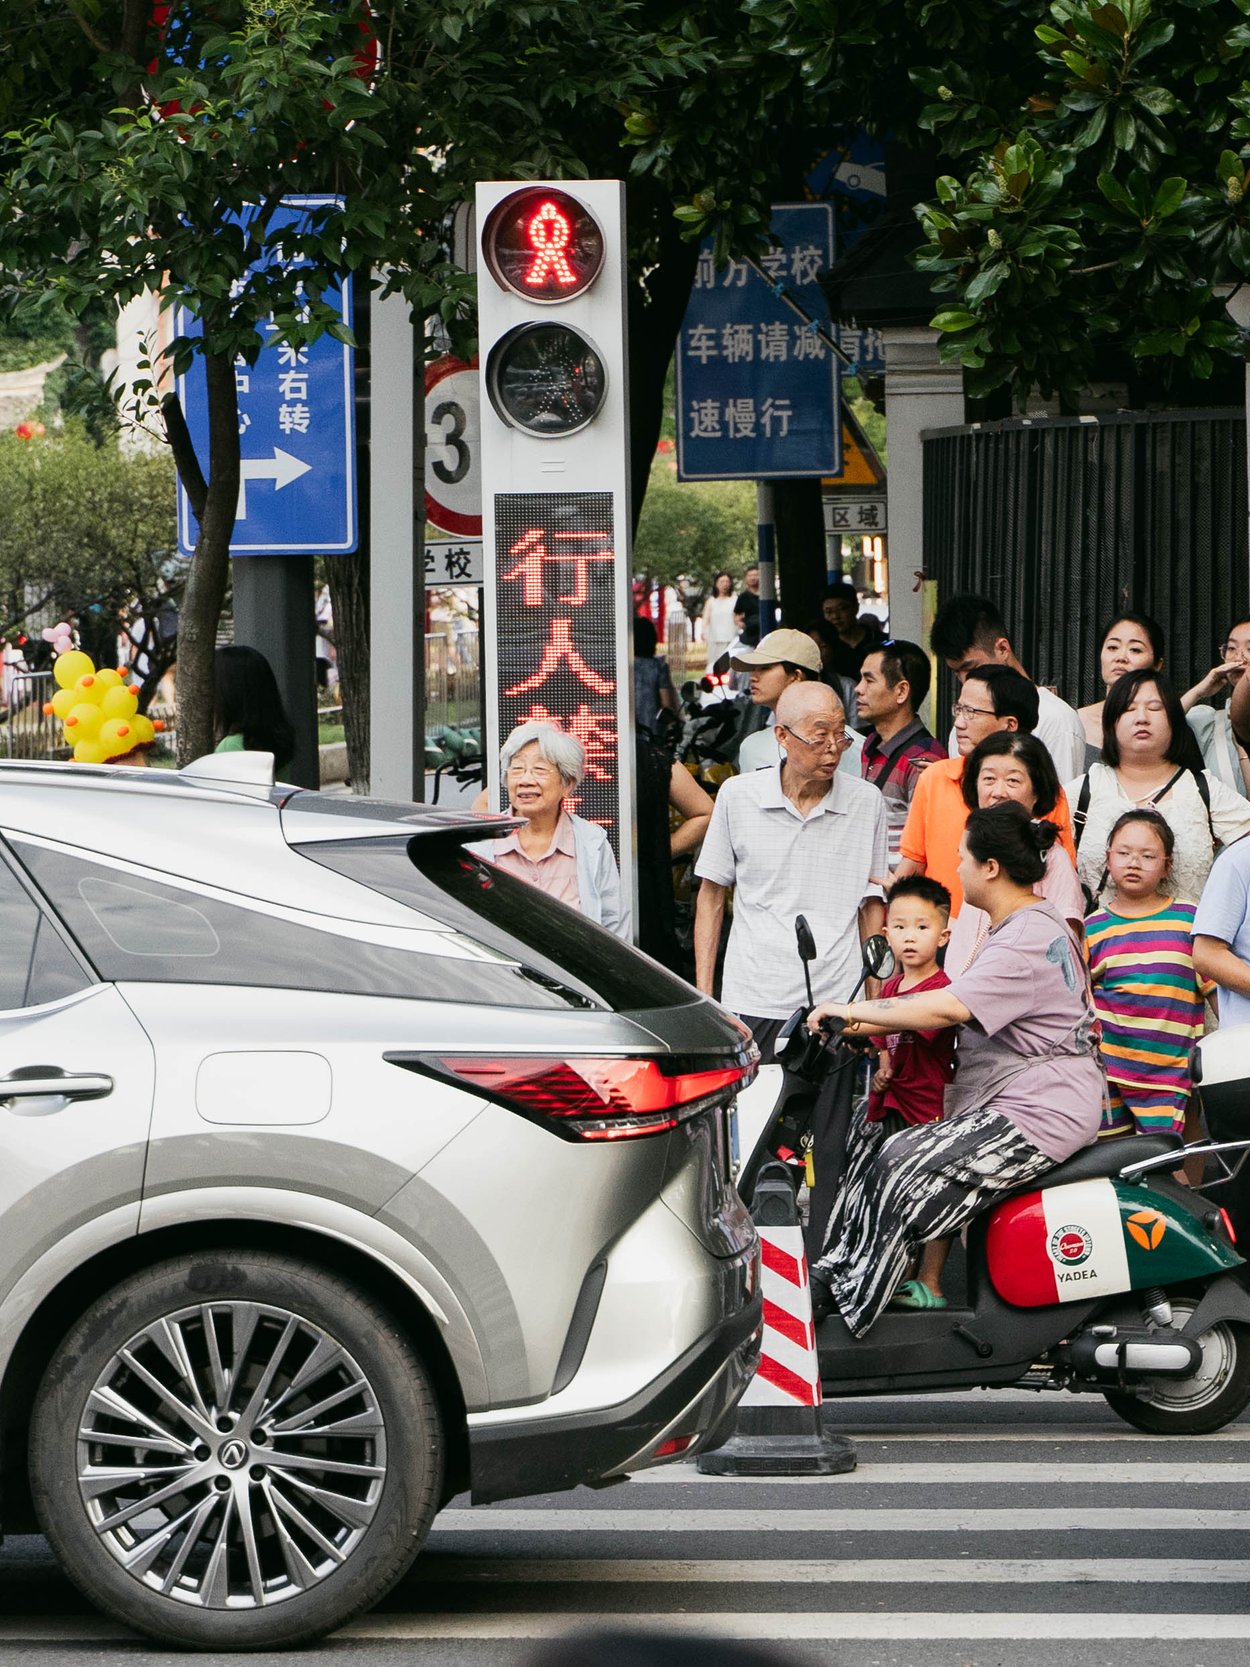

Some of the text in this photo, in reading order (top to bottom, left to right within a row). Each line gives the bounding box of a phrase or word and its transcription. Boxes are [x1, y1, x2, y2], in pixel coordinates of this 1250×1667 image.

[687, 321, 826, 365] 车辆请减
[689, 398, 793, 439] 速慢行
[431, 401, 471, 485] 3
[832, 504, 879, 528] 区域
[1057, 1269, 1098, 1283] YADEA
